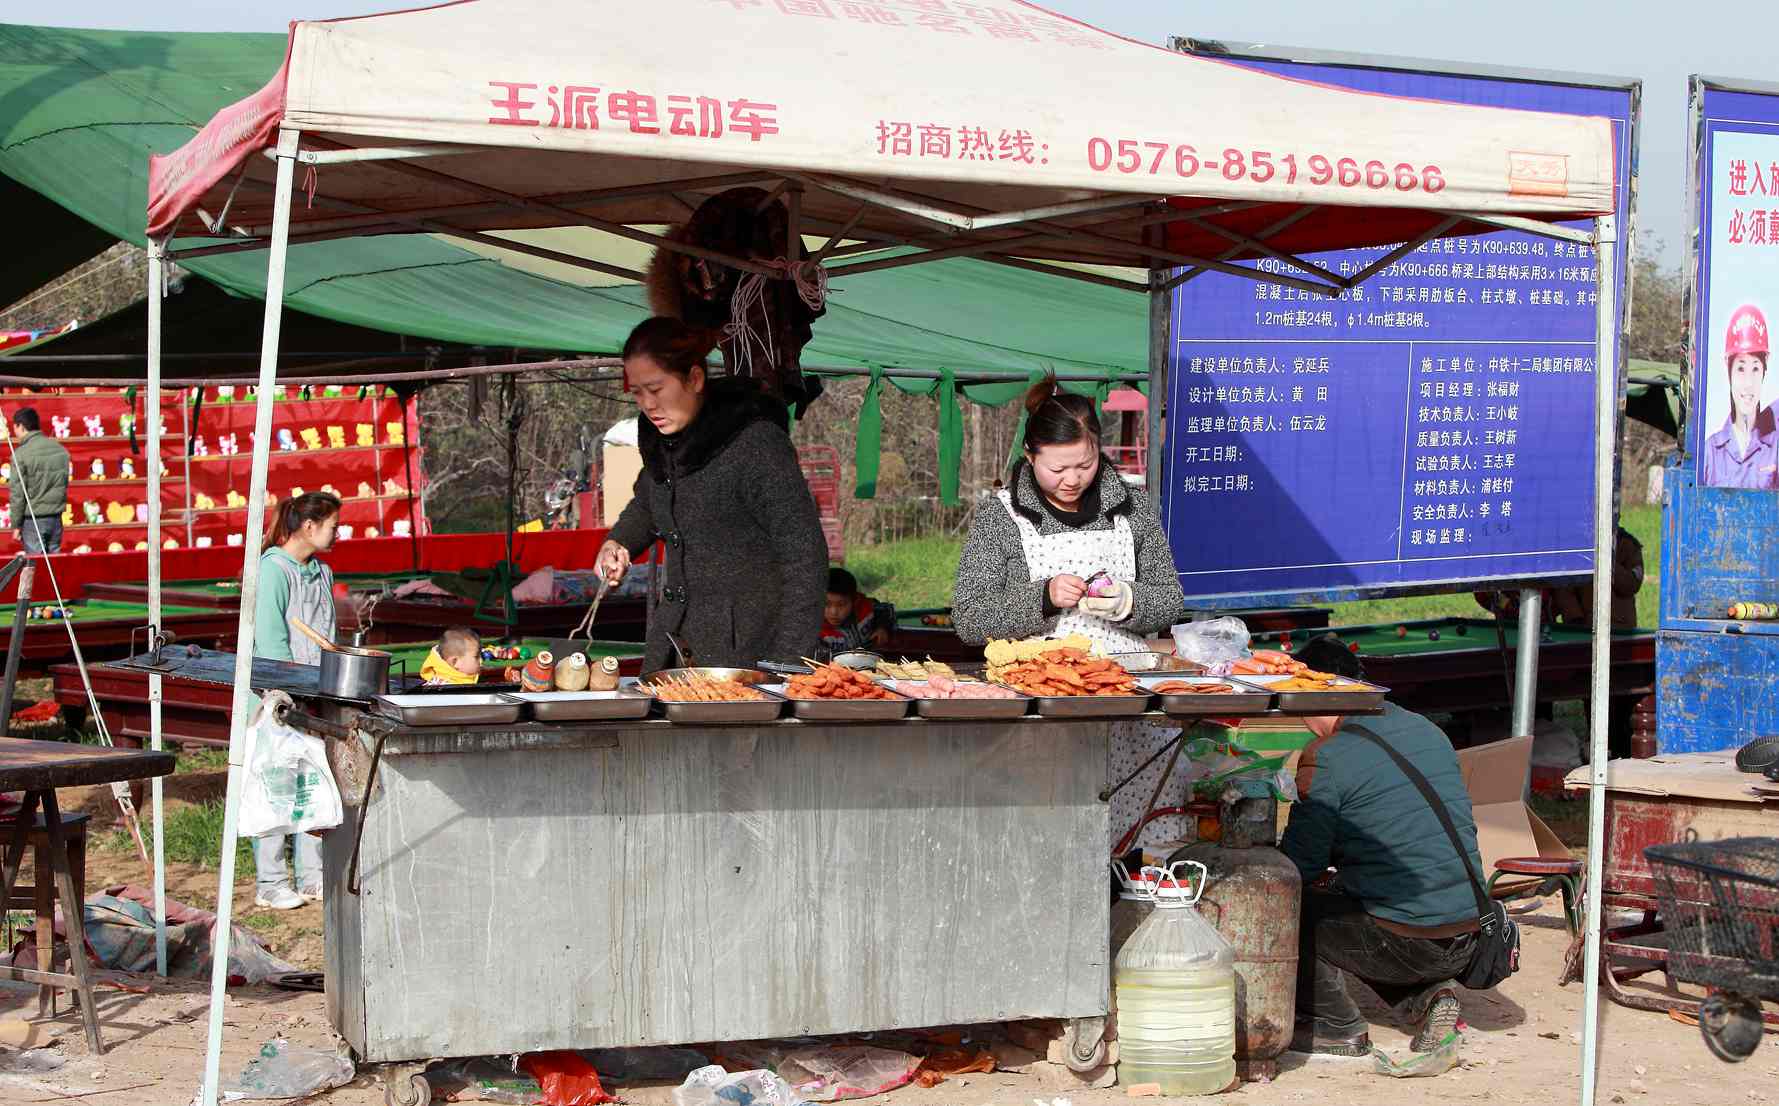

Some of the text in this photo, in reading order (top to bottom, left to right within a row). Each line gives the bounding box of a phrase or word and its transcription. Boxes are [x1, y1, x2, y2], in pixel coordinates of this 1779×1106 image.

[488, 81, 779, 142] 王派电动车
[875, 120, 1446, 195] 招商热线： 0576-85196666
[1186, 446, 1244, 463] 开工日期：
[1184, 474, 1255, 492] 拟完工日期：
[1410, 528, 1472, 545] 现场监理：
